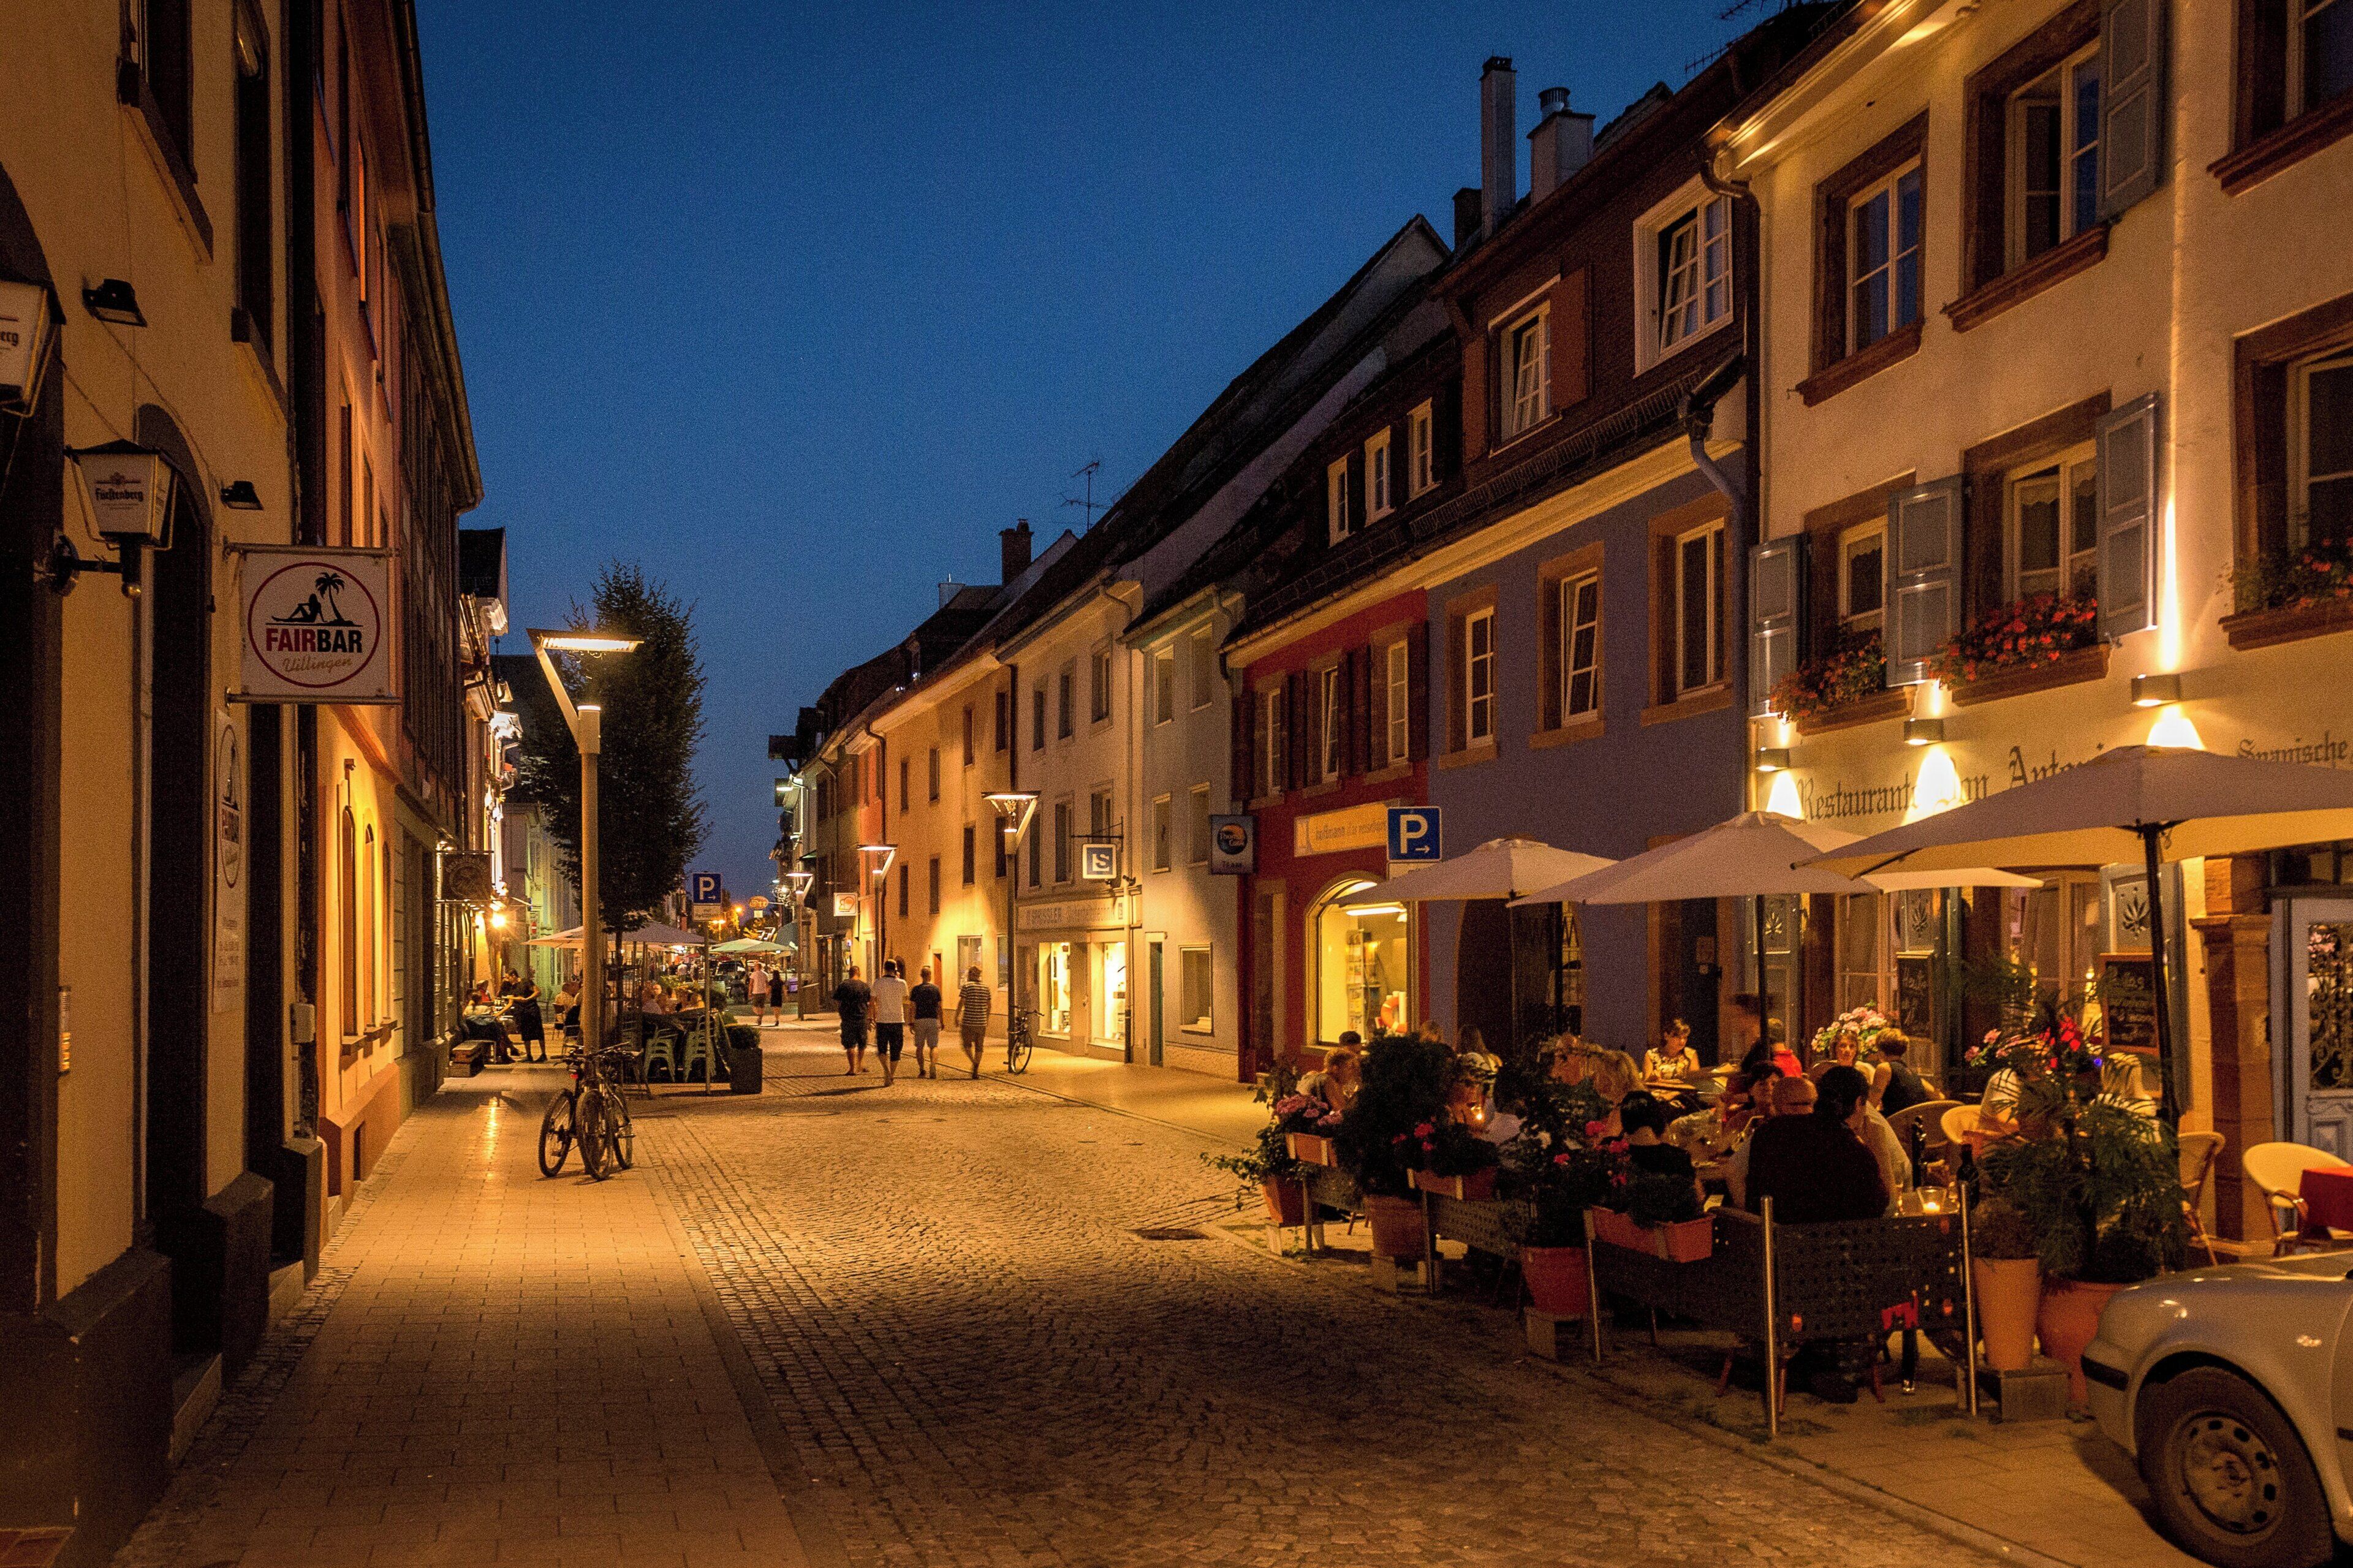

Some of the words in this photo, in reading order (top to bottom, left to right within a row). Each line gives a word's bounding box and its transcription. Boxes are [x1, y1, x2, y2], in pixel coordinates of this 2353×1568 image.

[266, 628, 363, 653] FAIRBAR
[282, 656, 354, 674] Villingen
[1400, 814, 1428, 854] P
[699, 876, 716, 901] P
